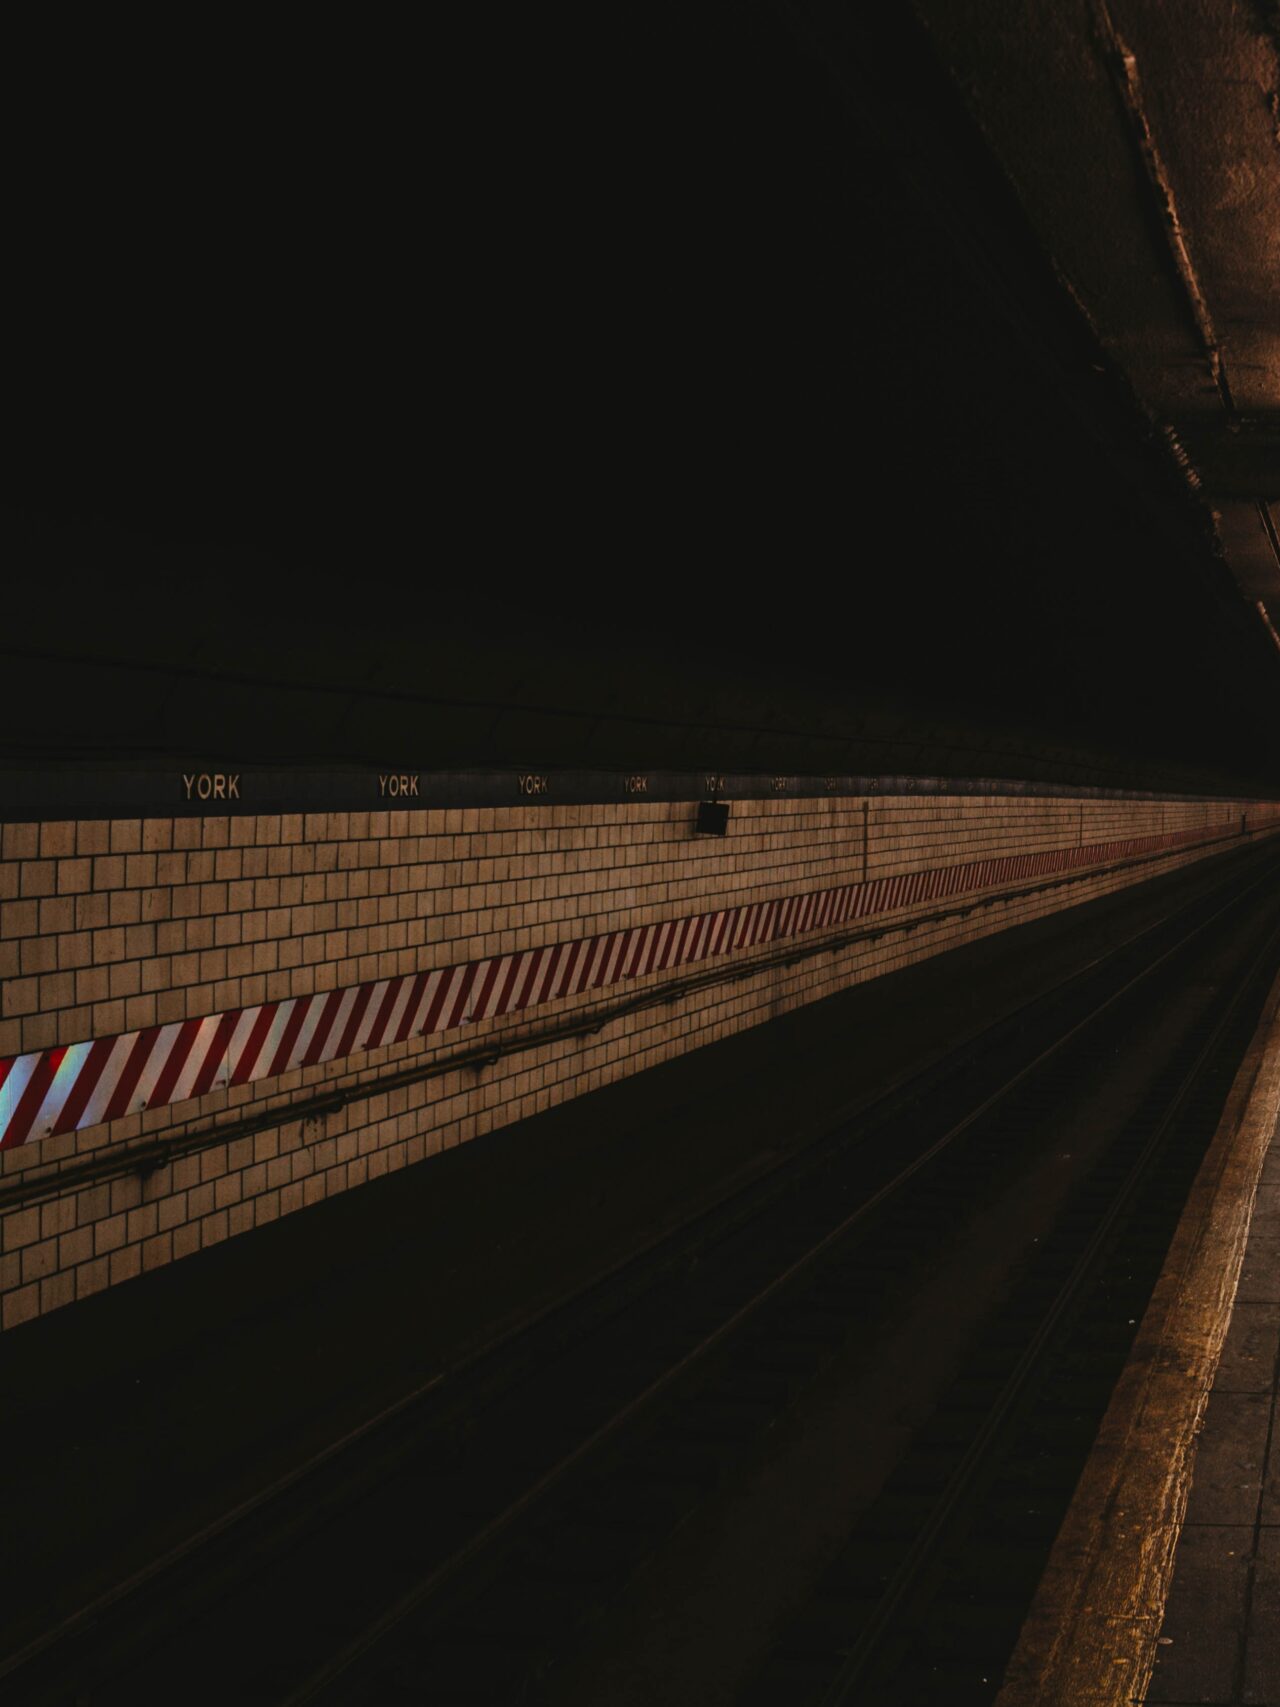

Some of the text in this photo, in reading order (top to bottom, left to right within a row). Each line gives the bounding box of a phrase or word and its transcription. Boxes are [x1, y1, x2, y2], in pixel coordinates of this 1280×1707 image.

[182, 773, 241, 800] YORK
[379, 775, 419, 797] YORK
[518, 775, 549, 794] YORK
[624, 775, 648, 793] YORK
